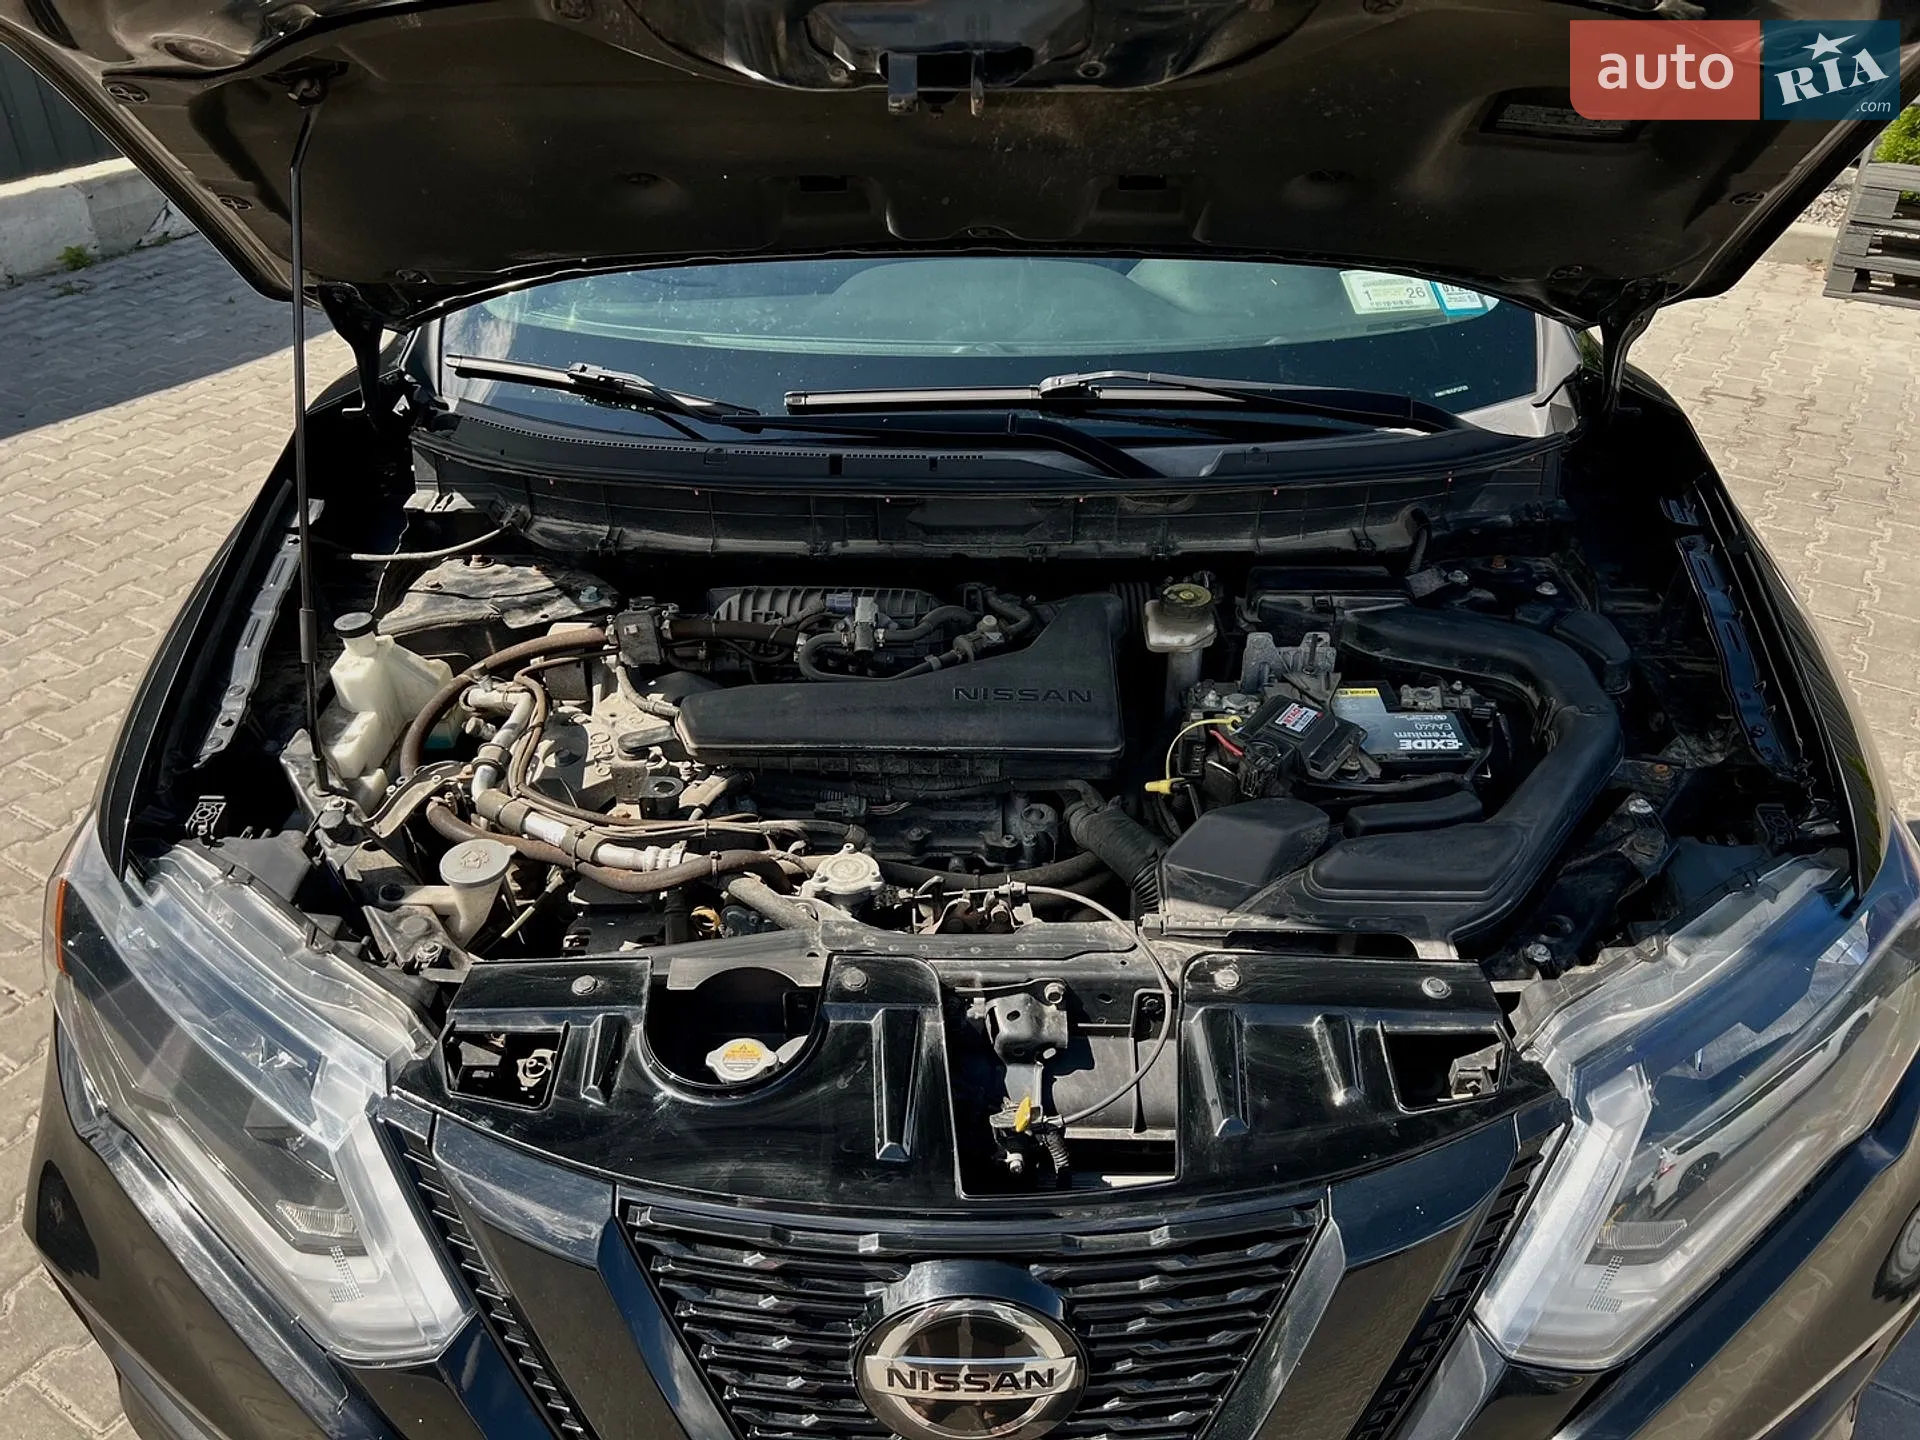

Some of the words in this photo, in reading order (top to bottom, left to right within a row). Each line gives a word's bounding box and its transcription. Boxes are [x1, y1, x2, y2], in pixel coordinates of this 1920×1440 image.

[1406, 287, 1426, 298] 26
[953, 687, 1091, 704] NISSAN
[1394, 731, 1456, 739] Premium
[1399, 739, 1463, 750] EXIDE
[887, 1368, 1054, 1393] NISSAN
